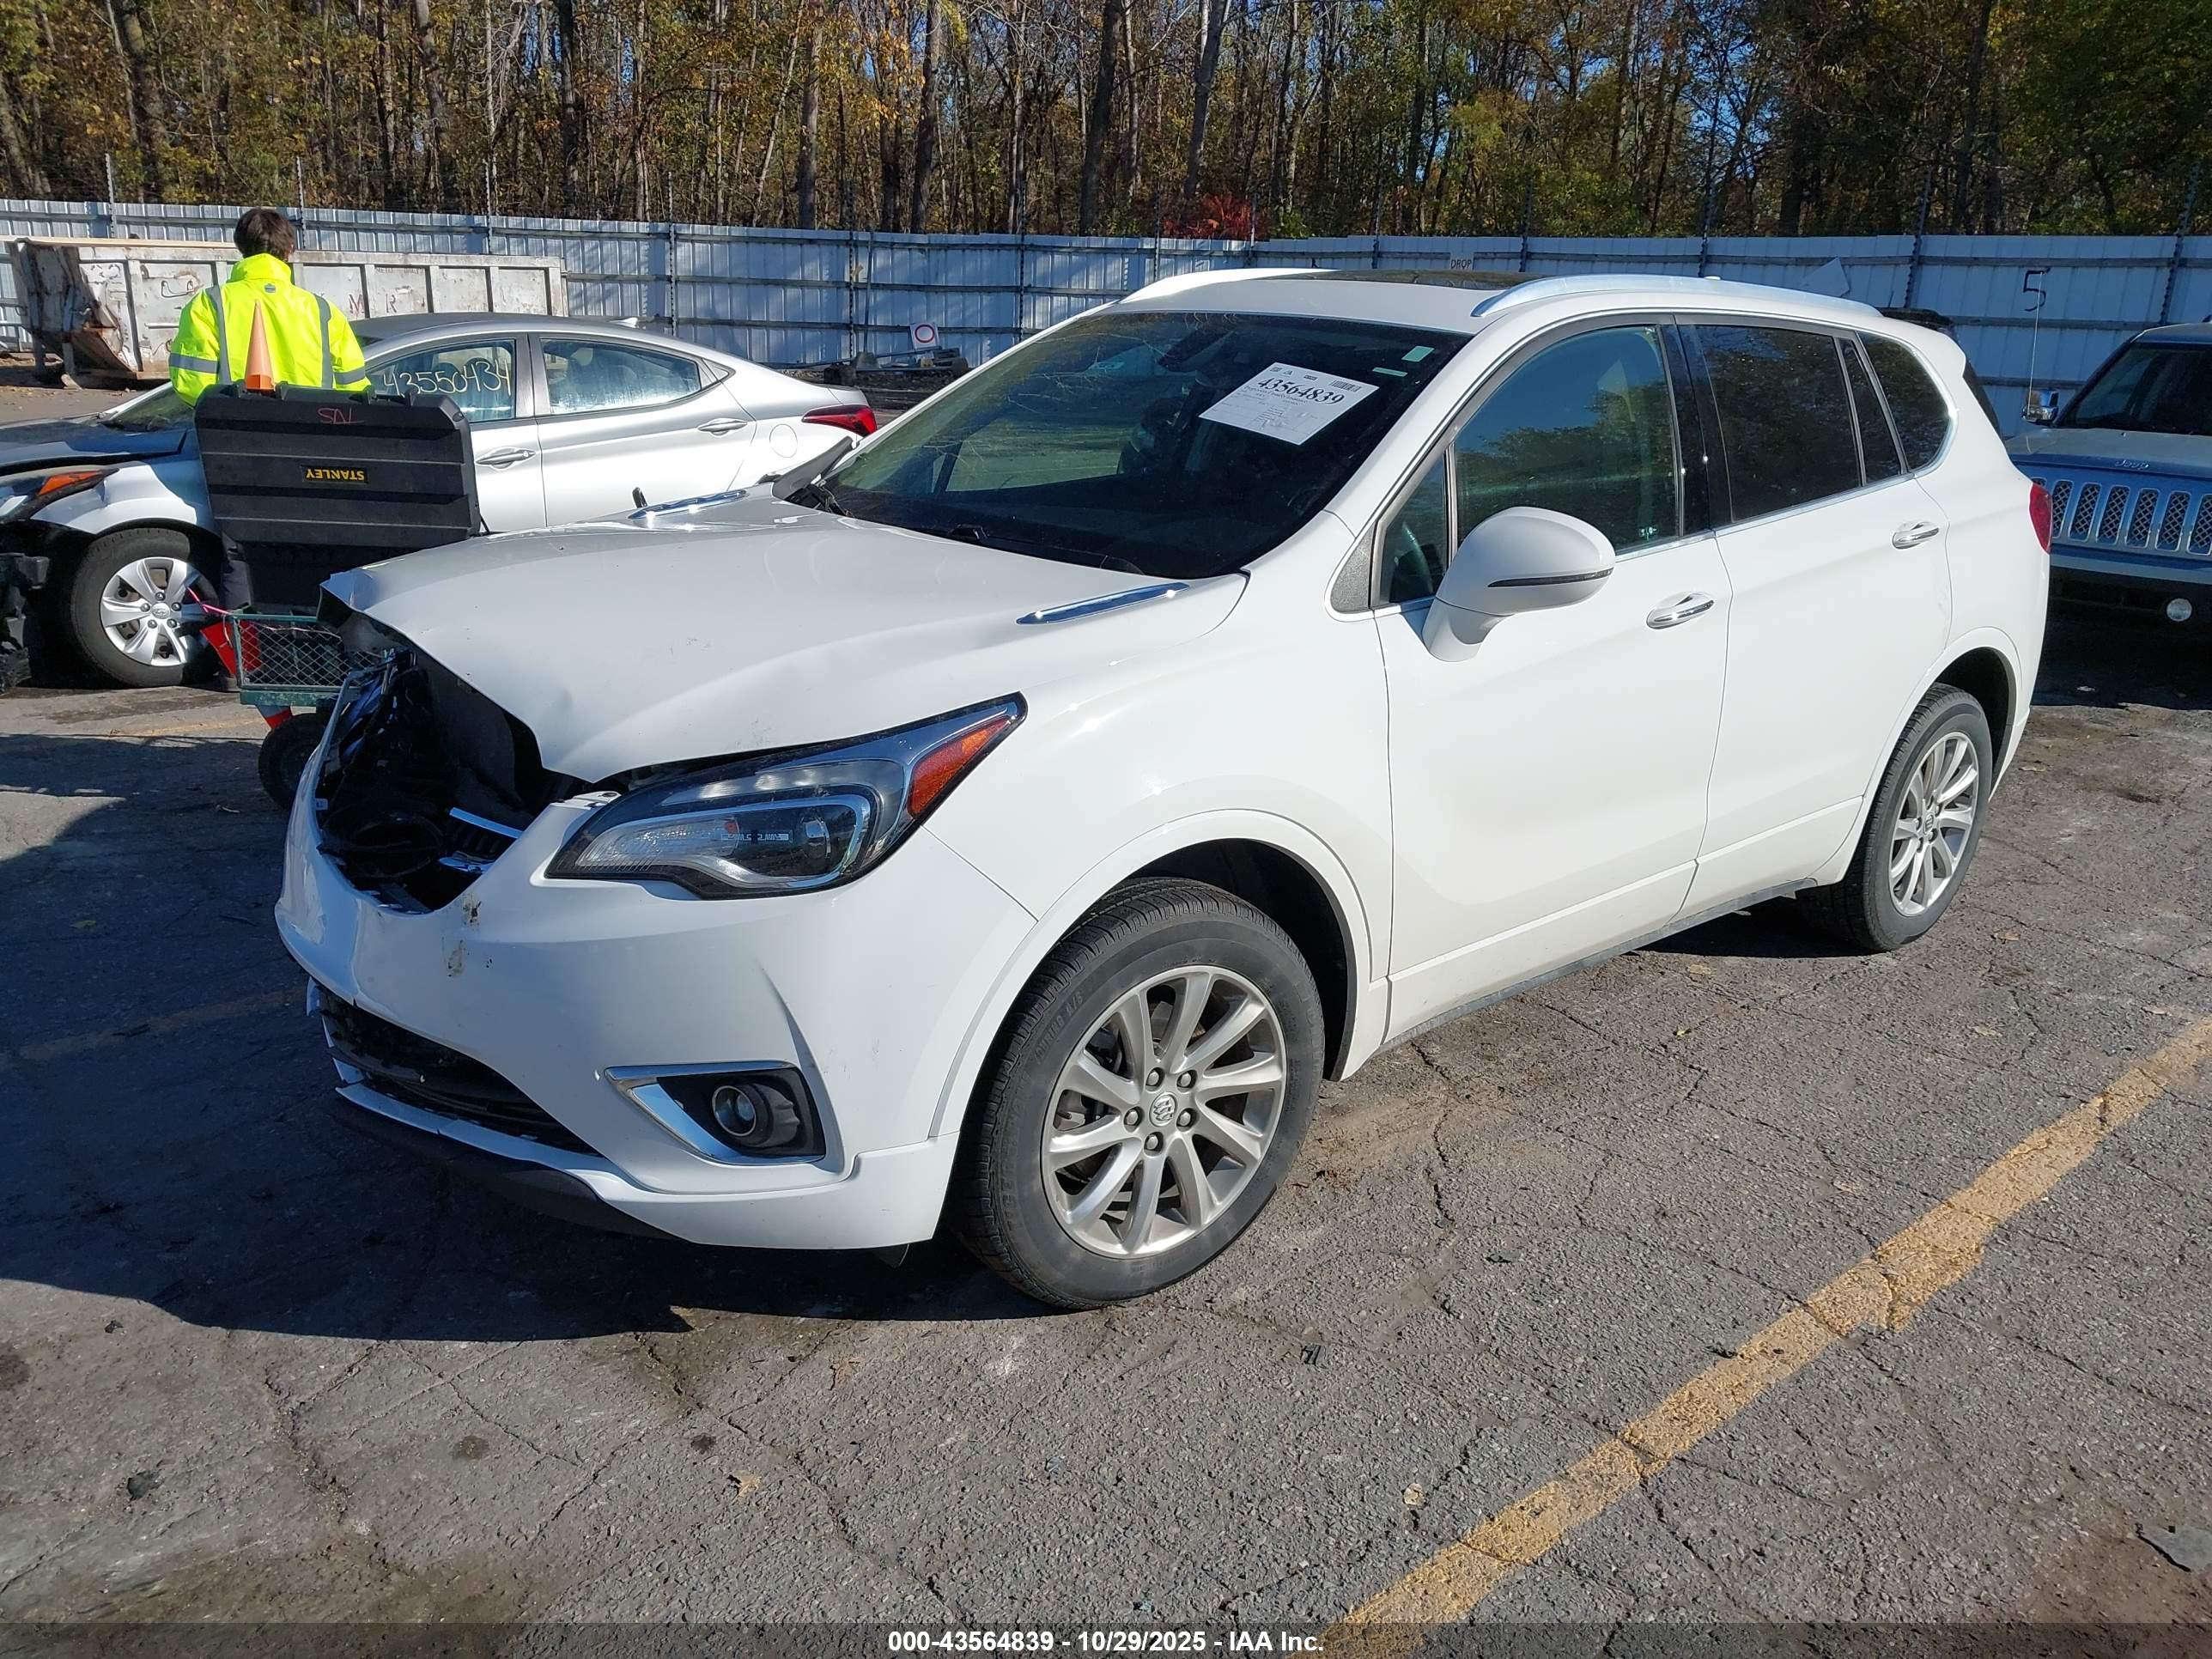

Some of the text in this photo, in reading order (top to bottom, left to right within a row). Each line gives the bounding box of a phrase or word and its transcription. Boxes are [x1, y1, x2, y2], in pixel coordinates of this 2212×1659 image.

[1450, 258, 1472, 270] DROP
[2022, 266, 2052, 313] 5
[383, 358, 512, 398] 43550434
[1257, 376, 1346, 405] 43564839
[306, 468, 366, 481] STANLEY
[2115, 459, 2150, 472] Jeep
